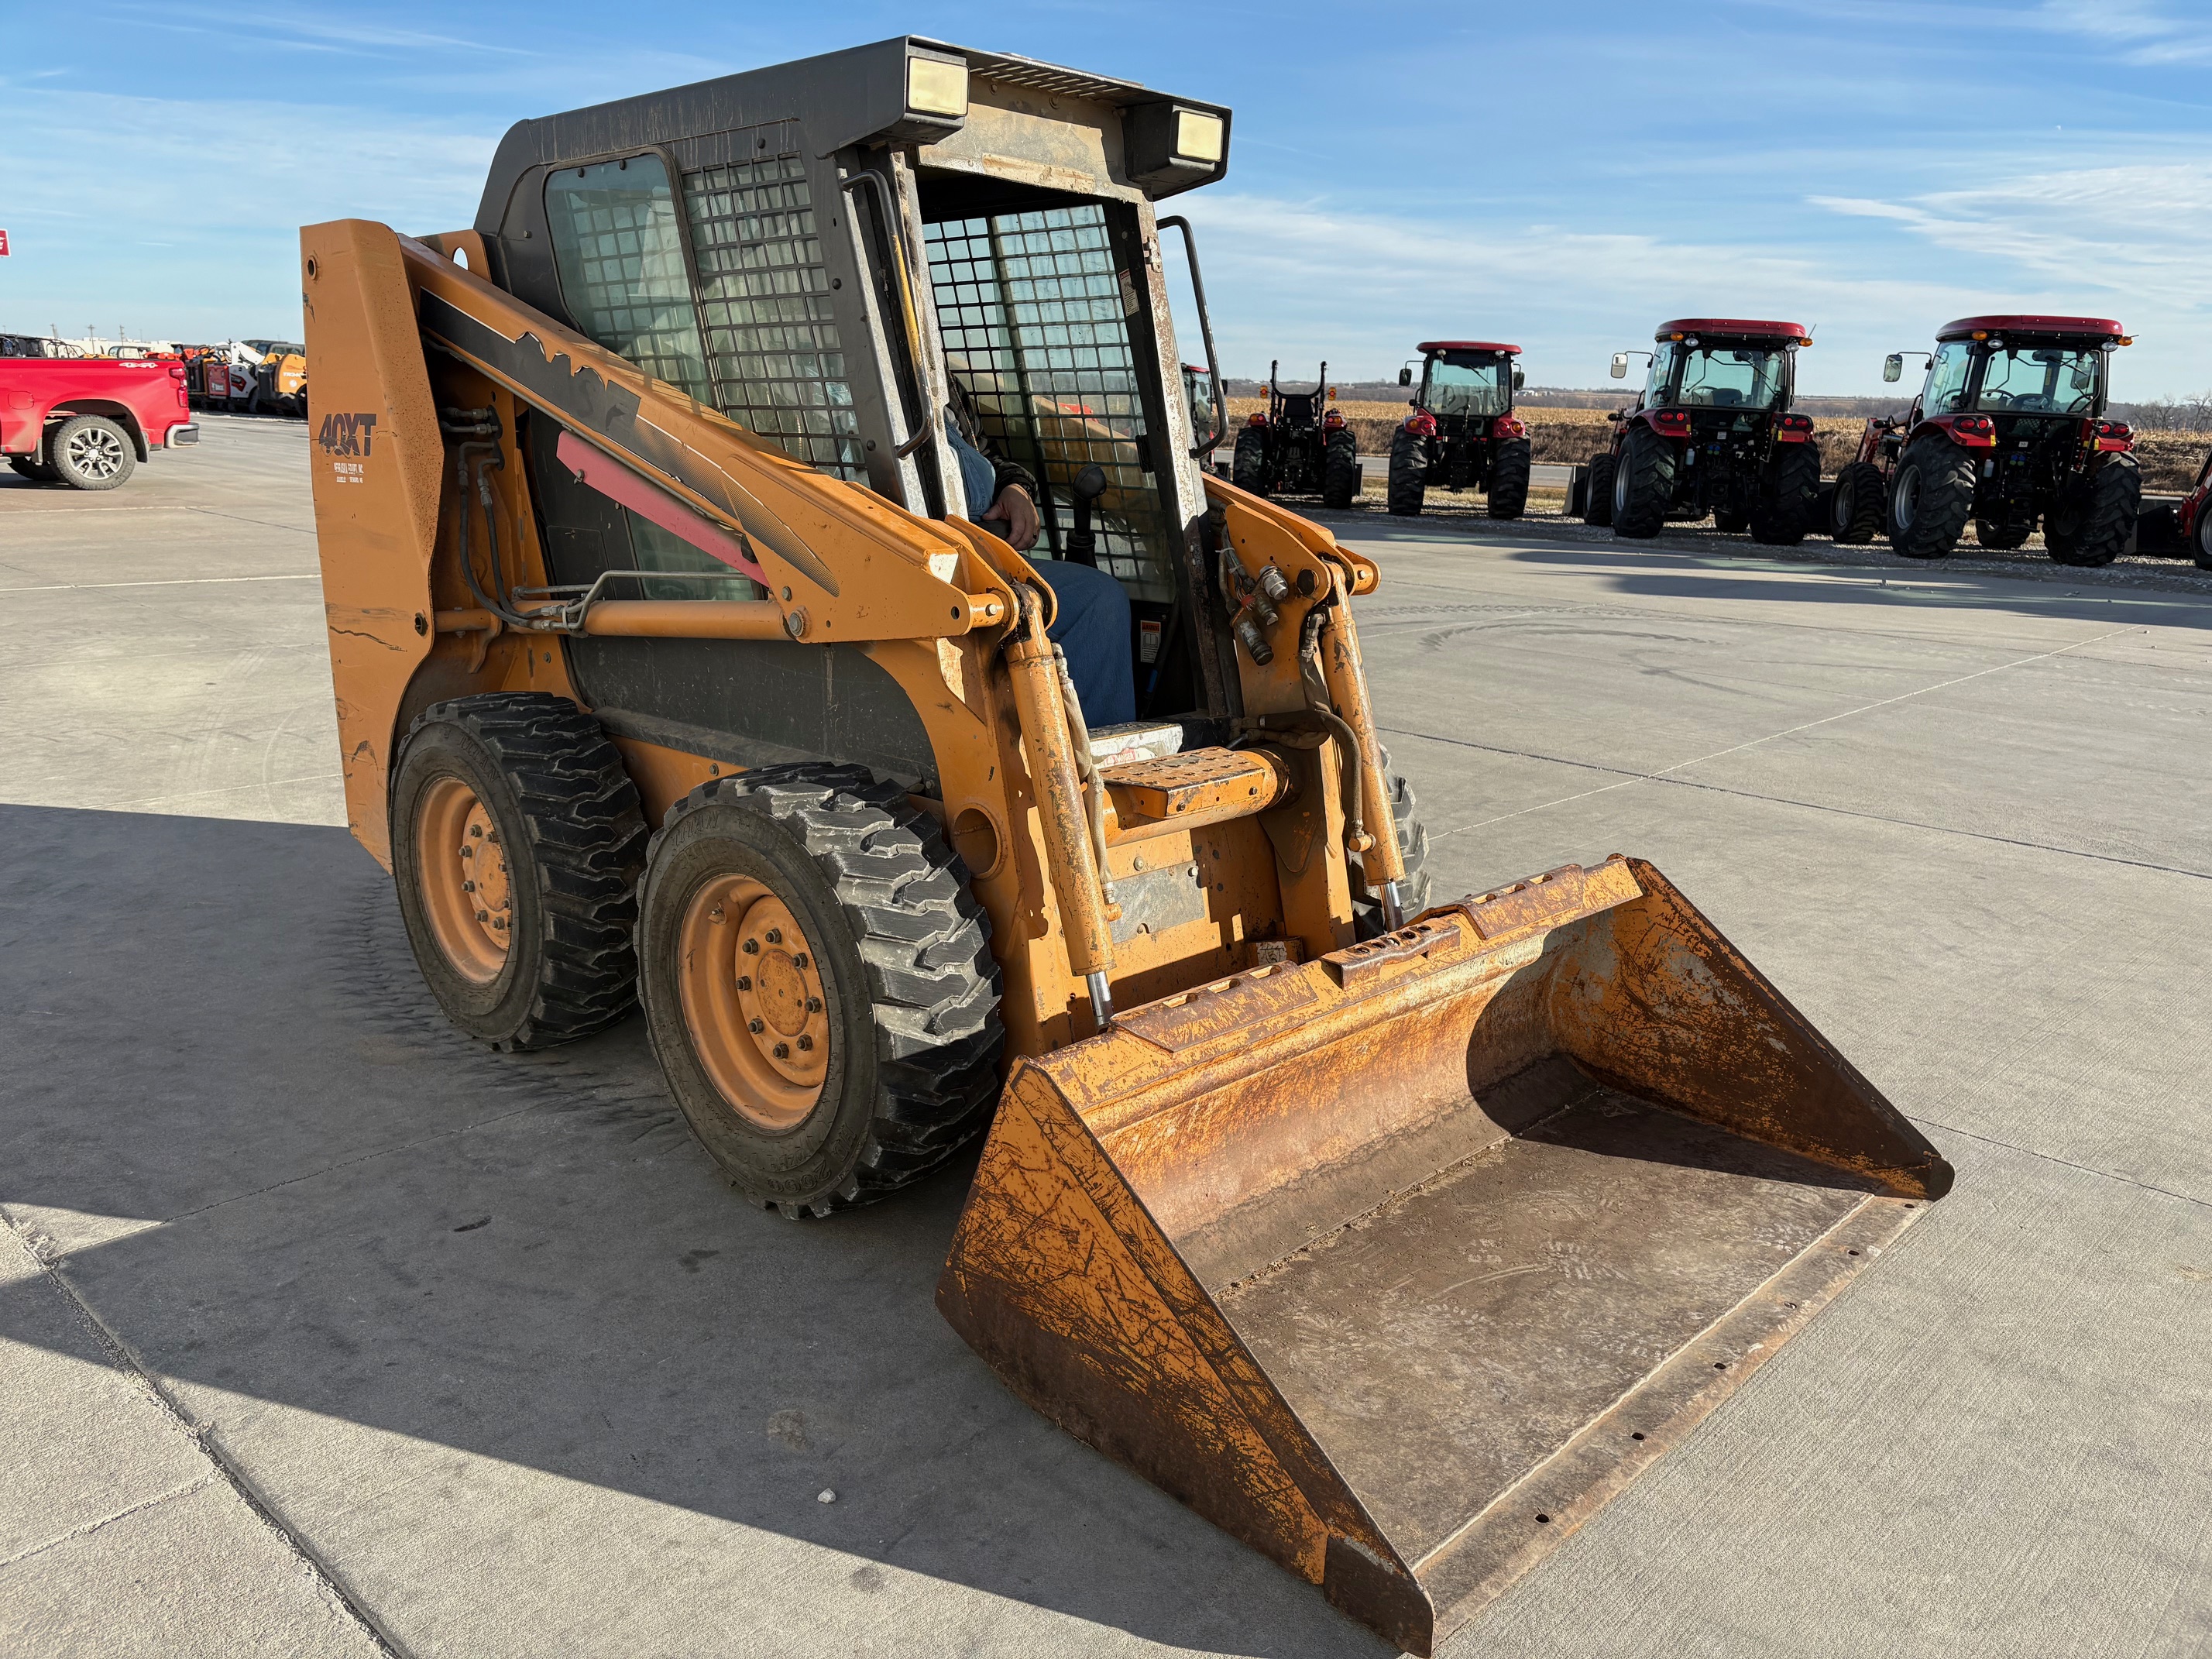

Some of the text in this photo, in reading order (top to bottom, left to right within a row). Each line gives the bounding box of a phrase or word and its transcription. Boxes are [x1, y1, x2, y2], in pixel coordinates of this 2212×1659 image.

[319, 413, 376, 456] 40XT
[459, 731, 501, 784] TITAN
[672, 810, 720, 847] TITAN
